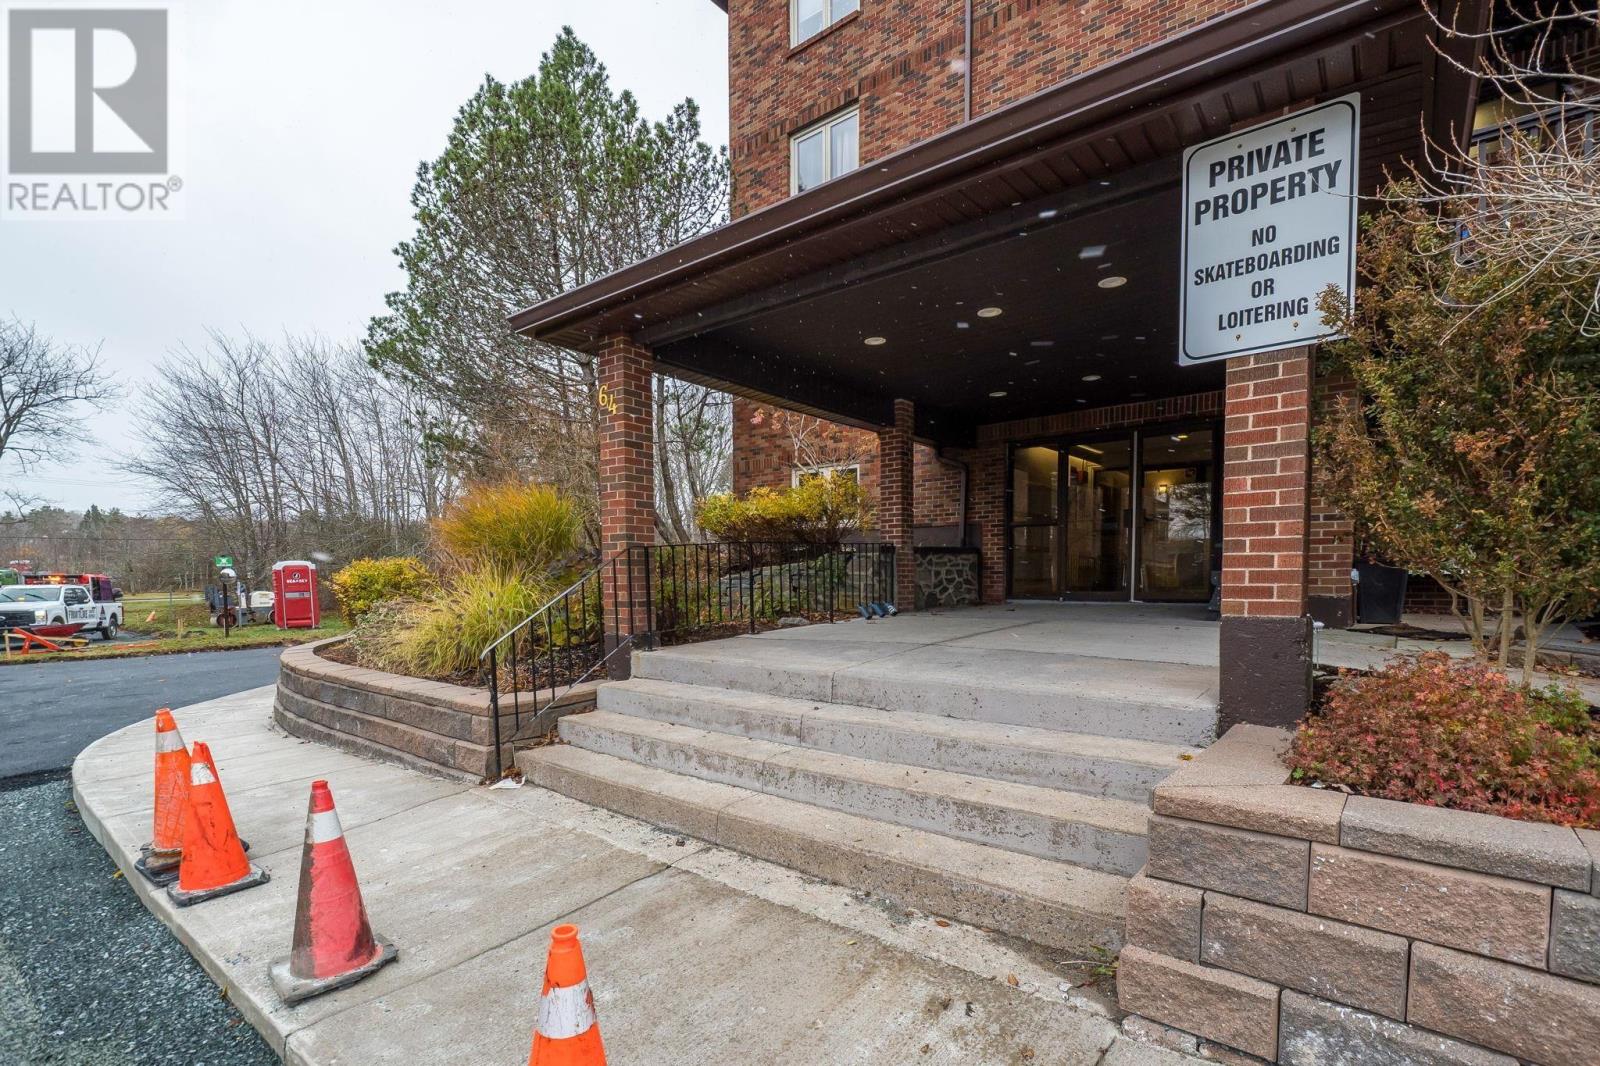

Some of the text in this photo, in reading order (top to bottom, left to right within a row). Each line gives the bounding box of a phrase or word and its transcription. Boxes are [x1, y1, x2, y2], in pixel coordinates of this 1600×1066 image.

[1209, 127, 1326, 188] PRIVATE
[1194, 159, 1343, 226] PROPERTY
[1251, 224, 1277, 247] NO
[1194, 235, 1341, 286] SKATEBOARDING
[1251, 277, 1275, 299] OR
[1218, 297, 1309, 331] LOITERING
[598, 383, 618, 415] 64
